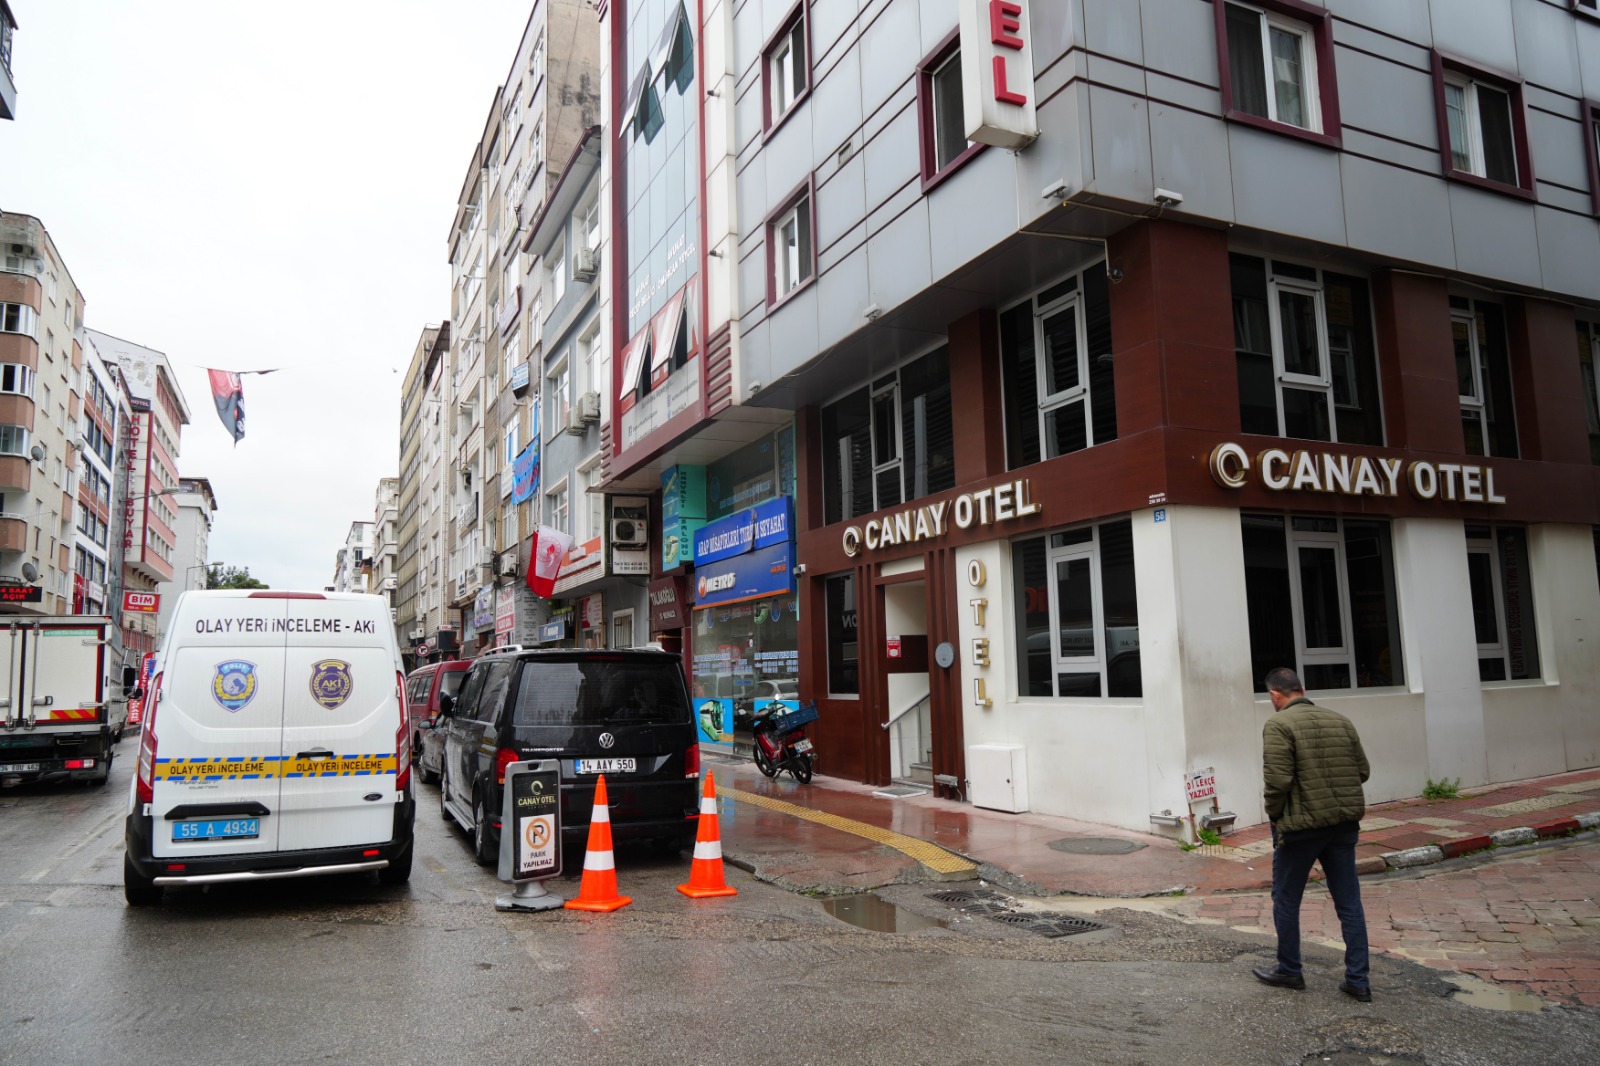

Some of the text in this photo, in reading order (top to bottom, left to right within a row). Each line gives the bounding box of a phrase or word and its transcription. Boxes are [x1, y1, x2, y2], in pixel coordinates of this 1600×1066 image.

[989, 0, 1027, 107] EL
[128, 415, 141, 471] HOTEL
[1258, 448, 1506, 503] CANAY OTEL
[865, 479, 1042, 550] CANAY OTEL
[760, 513, 785, 538] SEYAHAT
[195, 618, 232, 634] OLAY
[968, 559, 993, 706] OTEL
[170, 765, 194, 775] OLAY
[296, 762, 319, 772] OLAY
[581, 759, 634, 770] 14 AAY 550
[518, 795, 556, 806] CANAY OTEL
[1189, 786, 1215, 800] YAZILIR
[182, 820, 256, 837] 55 A 4934
[530, 851, 546, 859] PARK
[523, 859, 553, 869] YAPILMAZ
